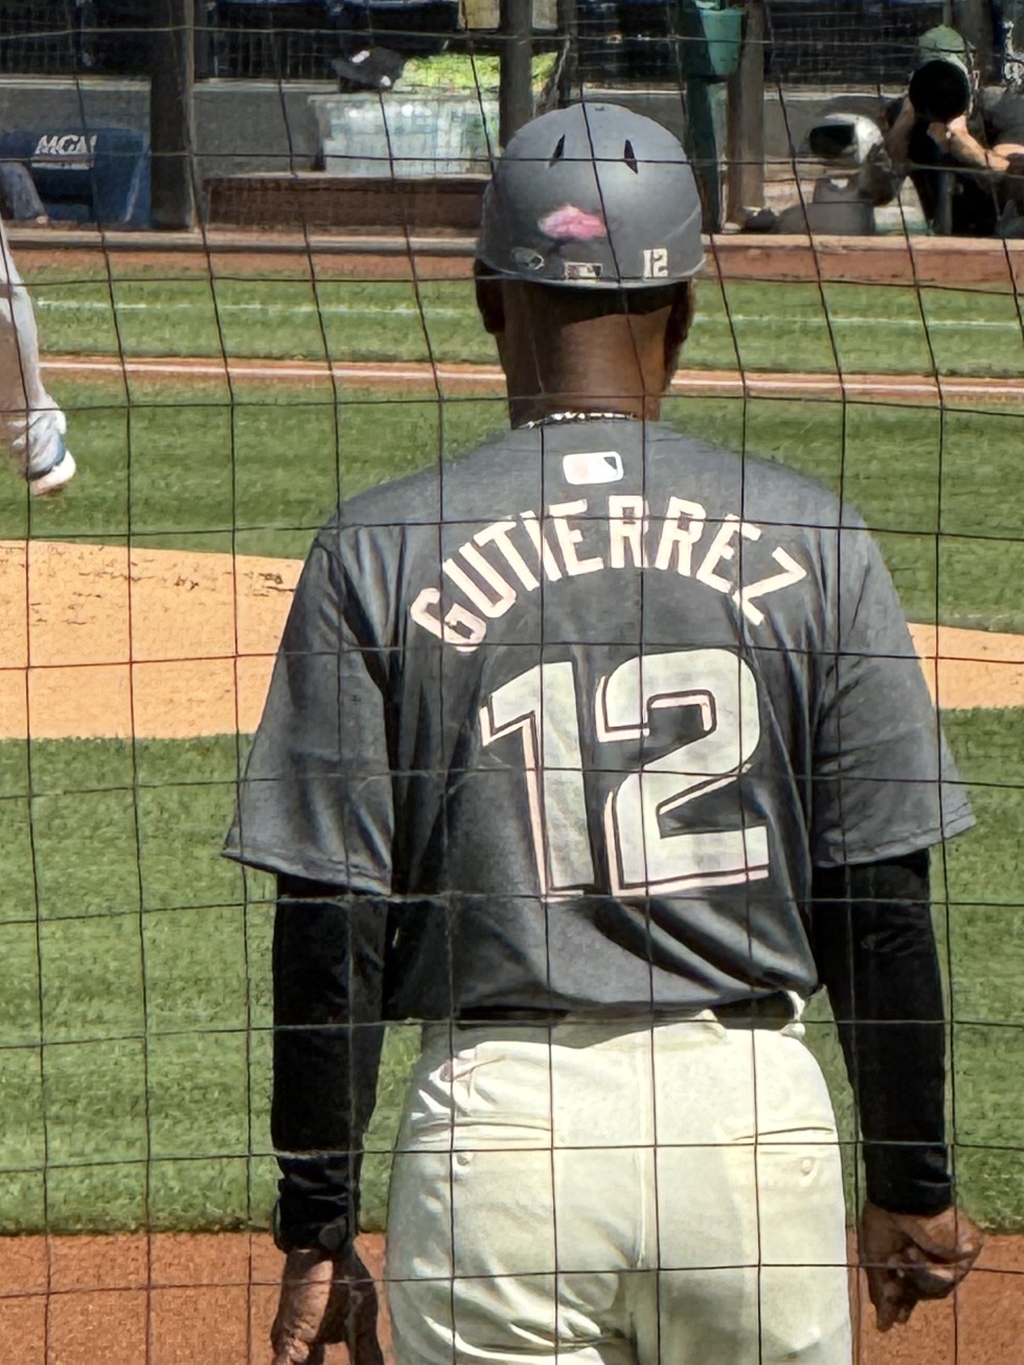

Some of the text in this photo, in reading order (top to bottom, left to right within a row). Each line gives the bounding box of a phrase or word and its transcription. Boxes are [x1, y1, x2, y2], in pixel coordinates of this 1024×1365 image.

[642, 247, 669, 280] 12
[409, 494, 808, 653] GUTIERREZ
[479, 647, 770, 902] 12
